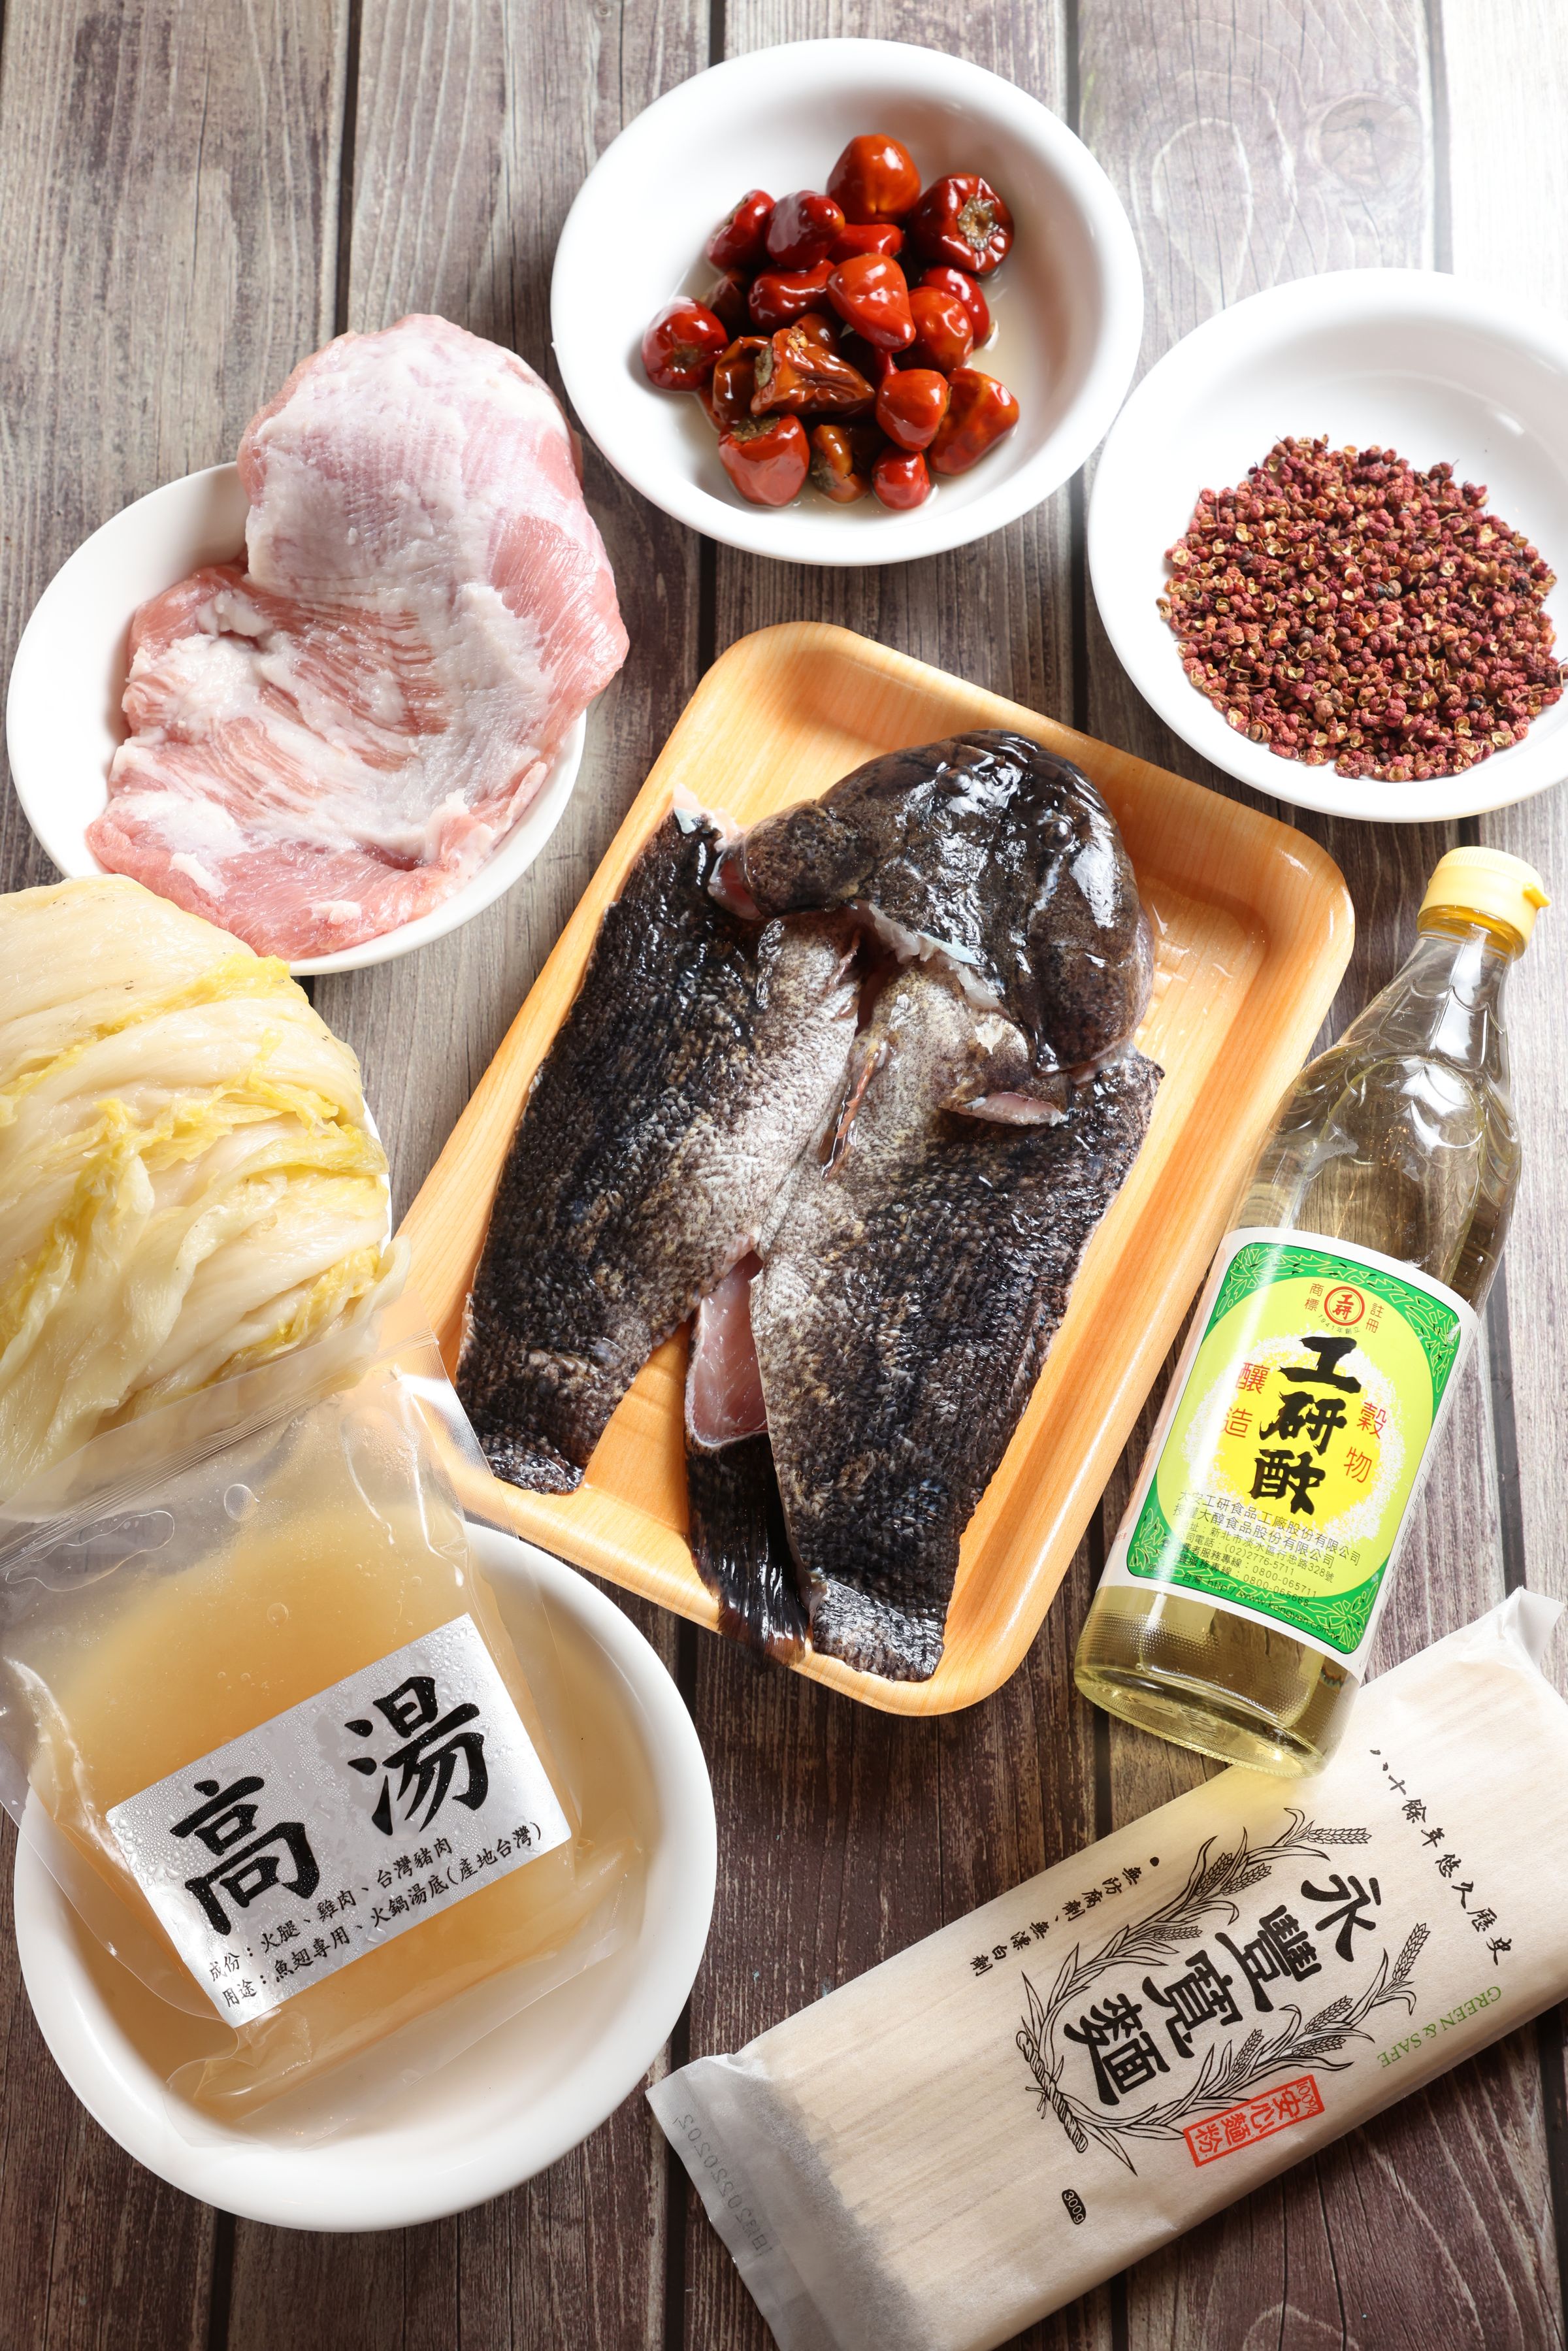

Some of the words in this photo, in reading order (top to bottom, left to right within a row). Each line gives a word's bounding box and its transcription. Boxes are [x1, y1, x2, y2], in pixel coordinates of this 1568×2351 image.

[1305, 1283, 1324, 1312] 商標
[1332, 1294, 1354, 1321] 工研
[1318, 1313, 1360, 1334] 1941年創立
[1365, 1302, 1384, 1334] 註冊
[1219, 1362, 1271, 1438] 釀造
[1343, 1401, 1388, 1484] 穀物
[1177, 1490, 1361, 1567] 大安工研食品工廠股份有限公司
[169, 1675, 490, 1937] 高湯
[1369, 1748, 1515, 1966] 八十餘年悠久歷史
[1063, 1874, 1383, 2107] 永豐寬麵
[1439, 1986, 1502, 2031] GREEN
[1377, 2033, 1422, 2068] SAFE
[1422, 2023, 1437, 2038] &
[1296, 2080, 1315, 2115] 100%
[1194, 2090, 1301, 2154] 安心麵粉
[1064, 2191, 1085, 2224] 300g
